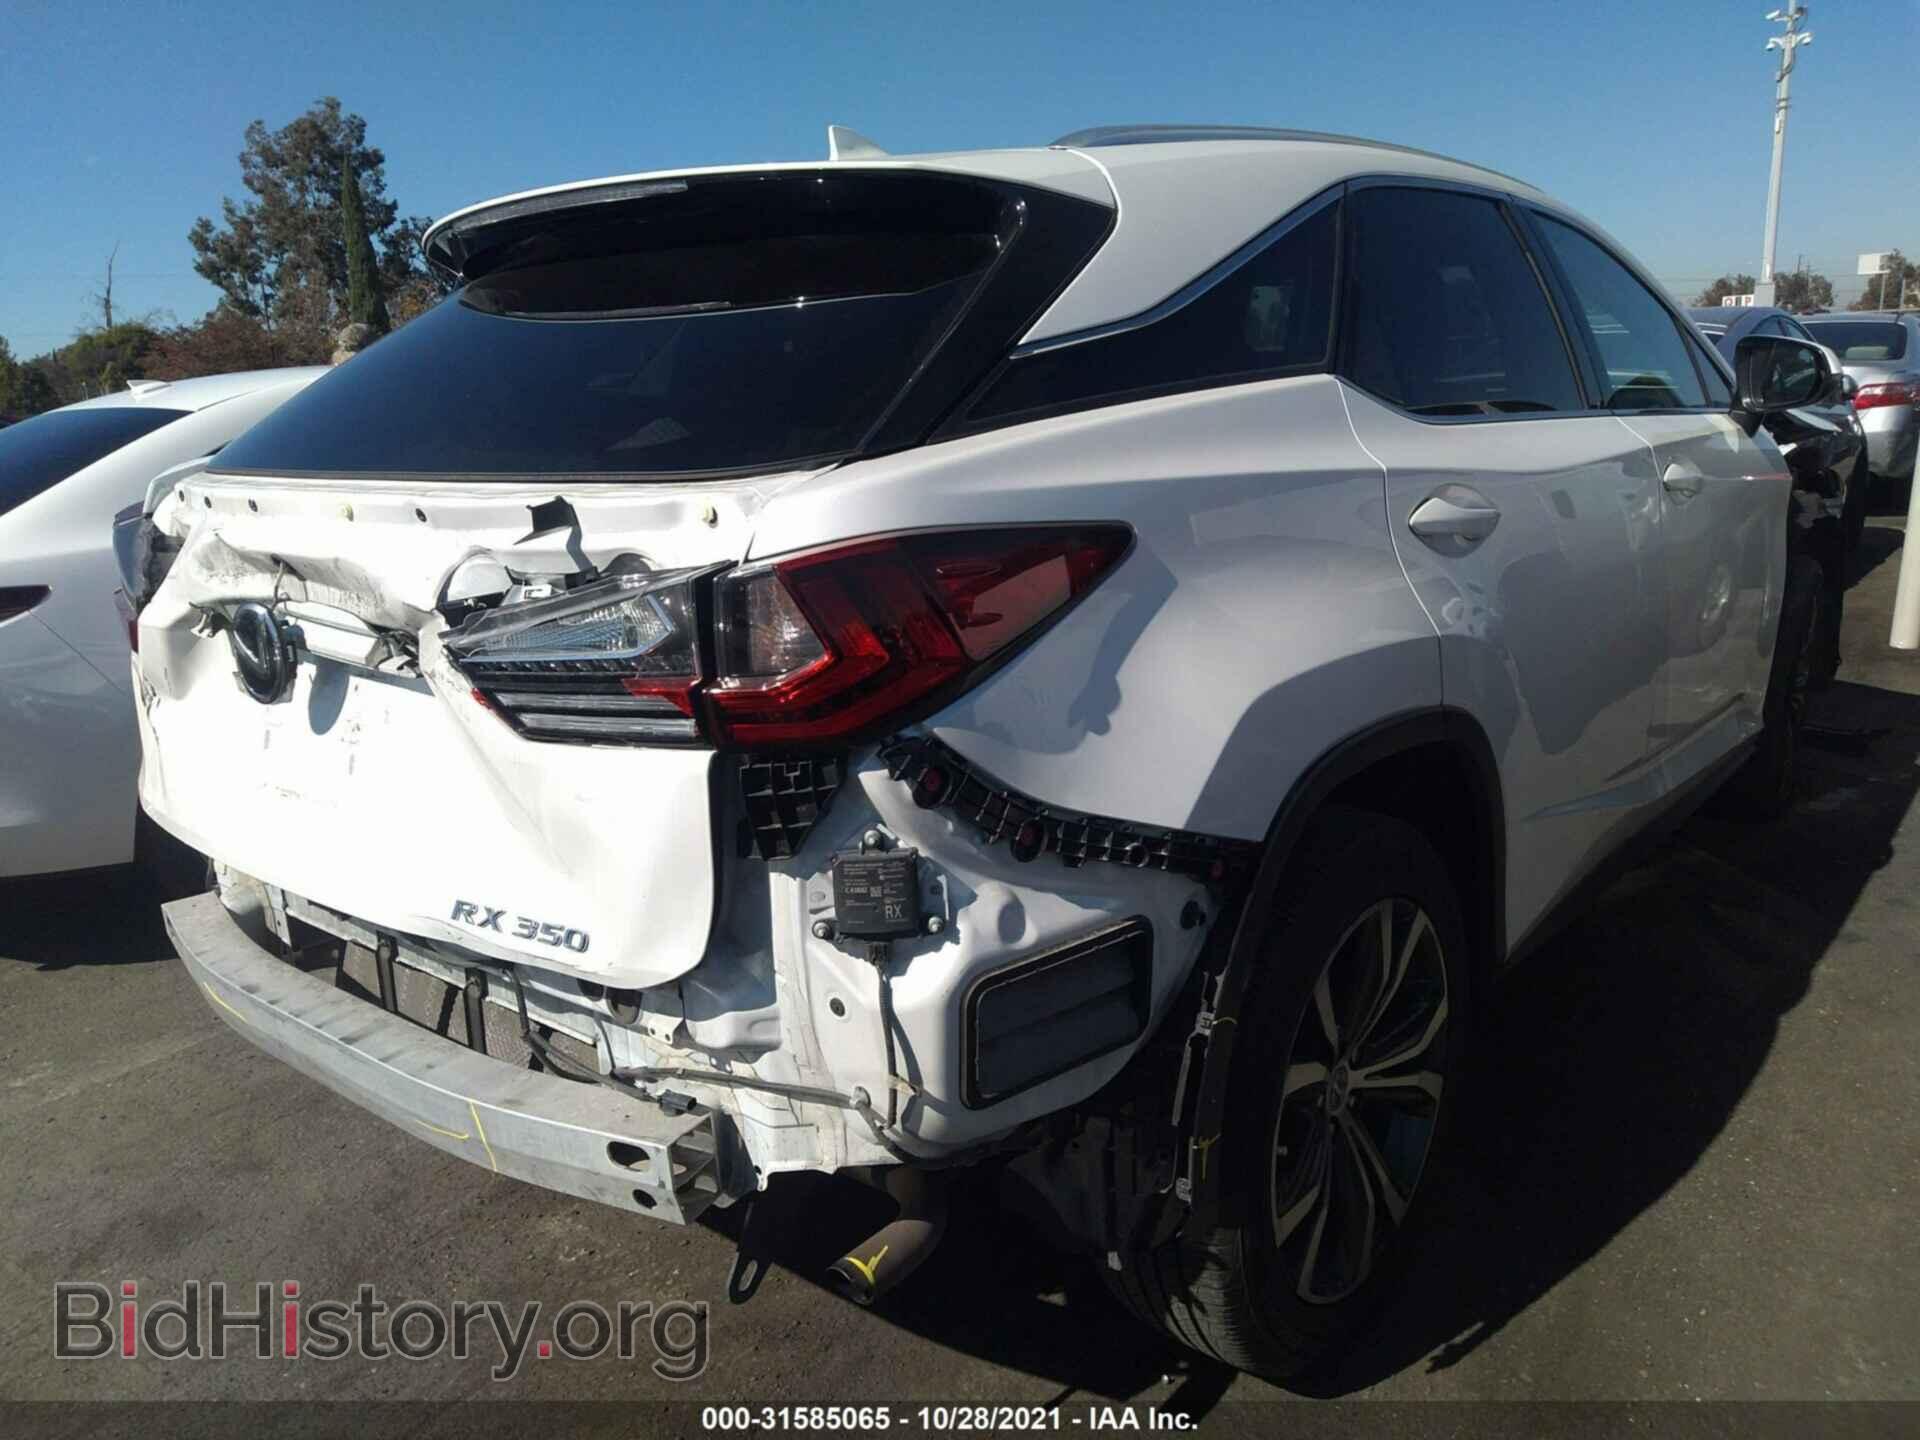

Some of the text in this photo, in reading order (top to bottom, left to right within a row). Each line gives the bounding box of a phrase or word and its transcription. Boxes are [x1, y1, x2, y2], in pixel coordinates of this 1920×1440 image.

[452, 900, 590, 953] RX 350
[885, 904, 902, 919] RX
